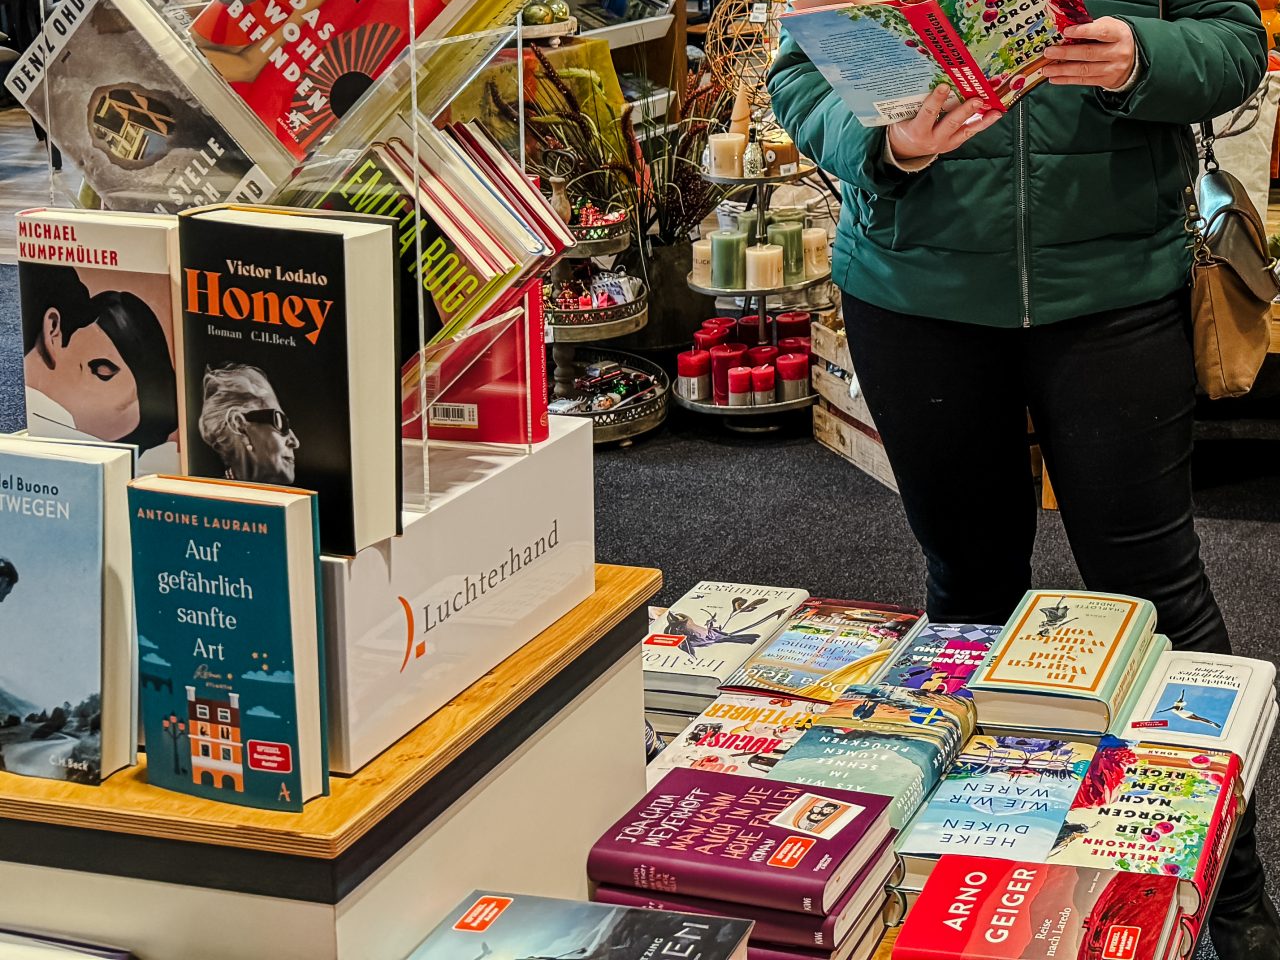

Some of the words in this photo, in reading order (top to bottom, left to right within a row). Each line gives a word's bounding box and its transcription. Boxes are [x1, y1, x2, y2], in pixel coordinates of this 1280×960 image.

[1003, 10, 1046, 39] NACH
[1015, 26, 1048, 48] DEM
[1015, 32, 1064, 66] REGEN
[168, 137, 225, 206] STELLE
[19, 221, 77, 241] MICHAEL
[340, 159, 427, 258] EMILIA
[408, 236, 478, 313] ROIG
[20, 242, 118, 266] KUMPFMÜLLER
[226, 259, 271, 279] Victor
[276, 266, 328, 286] Lodato
[184, 268, 334, 345] Honey
[208, 324, 242, 339] Roman
[250, 331, 296, 347] C.H.Beck
[17, 477, 59, 496] Buono
[138, 508, 198, 526] ANTOINE
[204, 517, 268, 534] LAURAIN
[185, 540, 221, 562] Auf
[158, 570, 253, 600] gefährlich
[423, 519, 559, 634] Luchterhand
[697, 583, 796, 601] Lichtungen
[1075, 604, 1125, 613] CHARLOTTE
[177, 607, 237, 630] sanfte
[193, 638, 225, 661] Art
[782, 640, 837, 655] Johanne
[801, 634, 863, 649] Johansen
[683, 658, 724, 672] Iris
[1030, 652, 1077, 662] sind
[738, 668, 798, 685] Held
[1008, 660, 1086, 674] Warten
[800, 676, 850, 694] Dora
[1047, 672, 1076, 683] Im
[1202, 679, 1240, 688] Daniela
[704, 704, 819, 726] SEPTEMBER
[695, 731, 783, 754] AUGUST
[824, 748, 888, 760] BLUMEN
[816, 758, 878, 770] SCHNEE
[1126, 767, 1186, 779] REGEN
[798, 776, 825, 787] WIR
[835, 783, 865, 791] ALS
[964, 783, 1049, 798] WAREN
[1131, 781, 1169, 791] DEM
[738, 786, 772, 805] DIE
[950, 794, 993, 806] WIR
[1120, 795, 1172, 806] NACH
[725, 807, 752, 820] IN
[1004, 799, 1048, 812] WIE
[615, 794, 680, 843] JOACHIM
[640, 786, 710, 847] MEYERHOFF
[666, 824, 707, 851] MAN
[693, 791, 737, 823] KANN
[720, 830, 764, 860] HÖHE
[748, 786, 804, 828] FALLEN
[1098, 808, 1183, 823] MORGEN
[942, 819, 1030, 835] DUKEN
[1116, 824, 1154, 835] DER
[694, 822, 742, 854] AUCH
[940, 833, 1016, 848] HEIKE
[1082, 837, 1175, 854] LEVENSOHN
[748, 838, 776, 862] ROMAN
[1091, 849, 1159, 862] MELANIE
[942, 871, 988, 931] ARNO
[985, 868, 1036, 943] GEIGER
[1035, 918, 1052, 940] Reise
[1046, 934, 1061, 957] nach
[1055, 907, 1072, 935] Laredo
